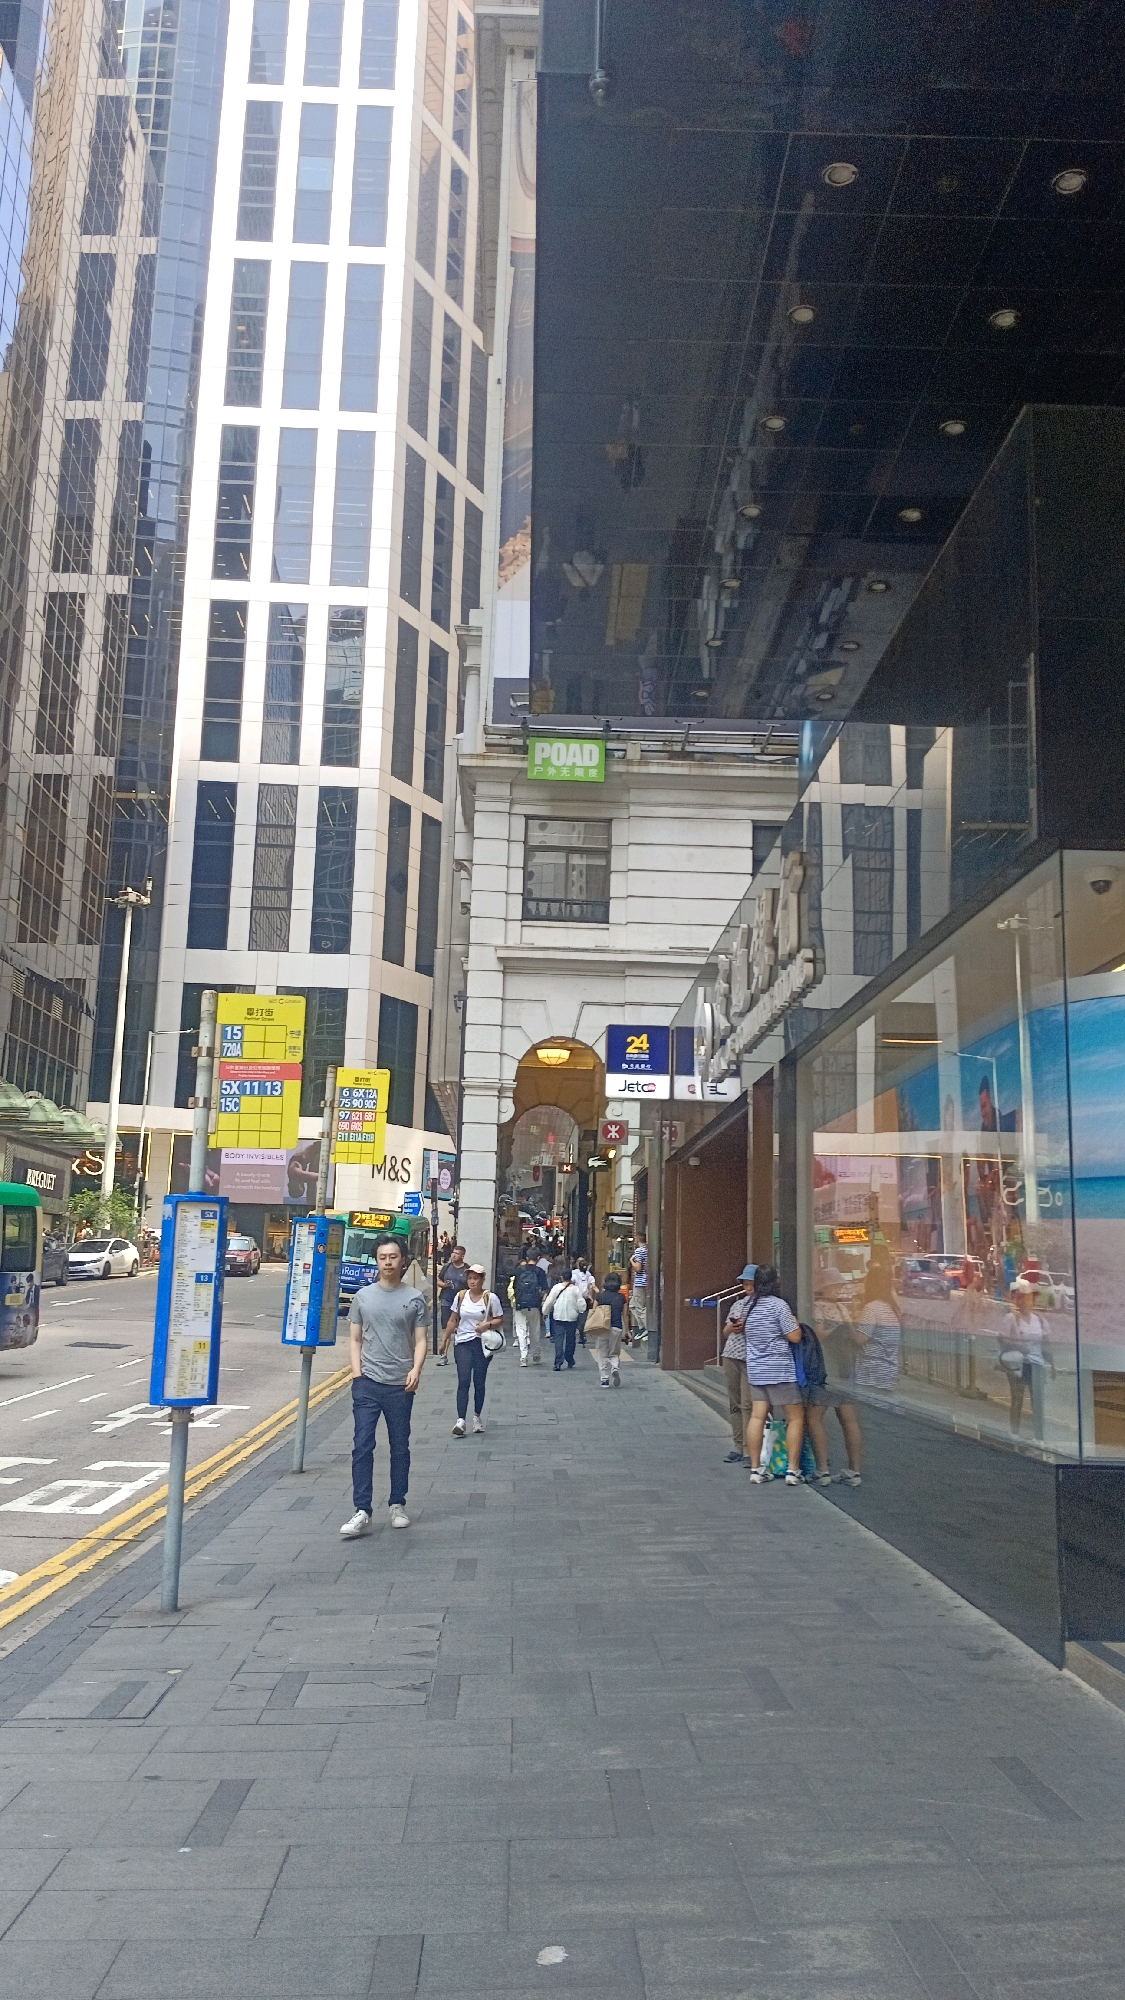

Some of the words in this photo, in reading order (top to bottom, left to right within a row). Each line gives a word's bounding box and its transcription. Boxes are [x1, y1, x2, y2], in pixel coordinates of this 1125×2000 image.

[535, 743, 599, 766] POAD
[225, 1026, 242, 1039] 15
[222, 1042, 242, 1057] 720A
[626, 1034, 649, 1053] 24
[221, 1081, 240, 1095] 5X
[244, 1081, 259, 1095] 11
[265, 1081, 282, 1095] 13
[342, 1088, 350, 1097] 6
[353, 1089, 365, 1098] 6X
[366, 1089, 377, 1099] 12A
[220, 1097, 239, 1112] 15C
[340, 1099, 351, 1107] 75
[352, 1099, 363, 1108] 90
[364, 1100, 377, 1109] 90C
[339, 1111, 350, 1120] 97
[351, 1111, 363, 1121] 621
[337, 1132, 348, 1141] E11
[246, 1153, 284, 1161] INVISIBLES
[372, 1155, 411, 1183] M&S
[353, 1212, 361, 1225] 2
